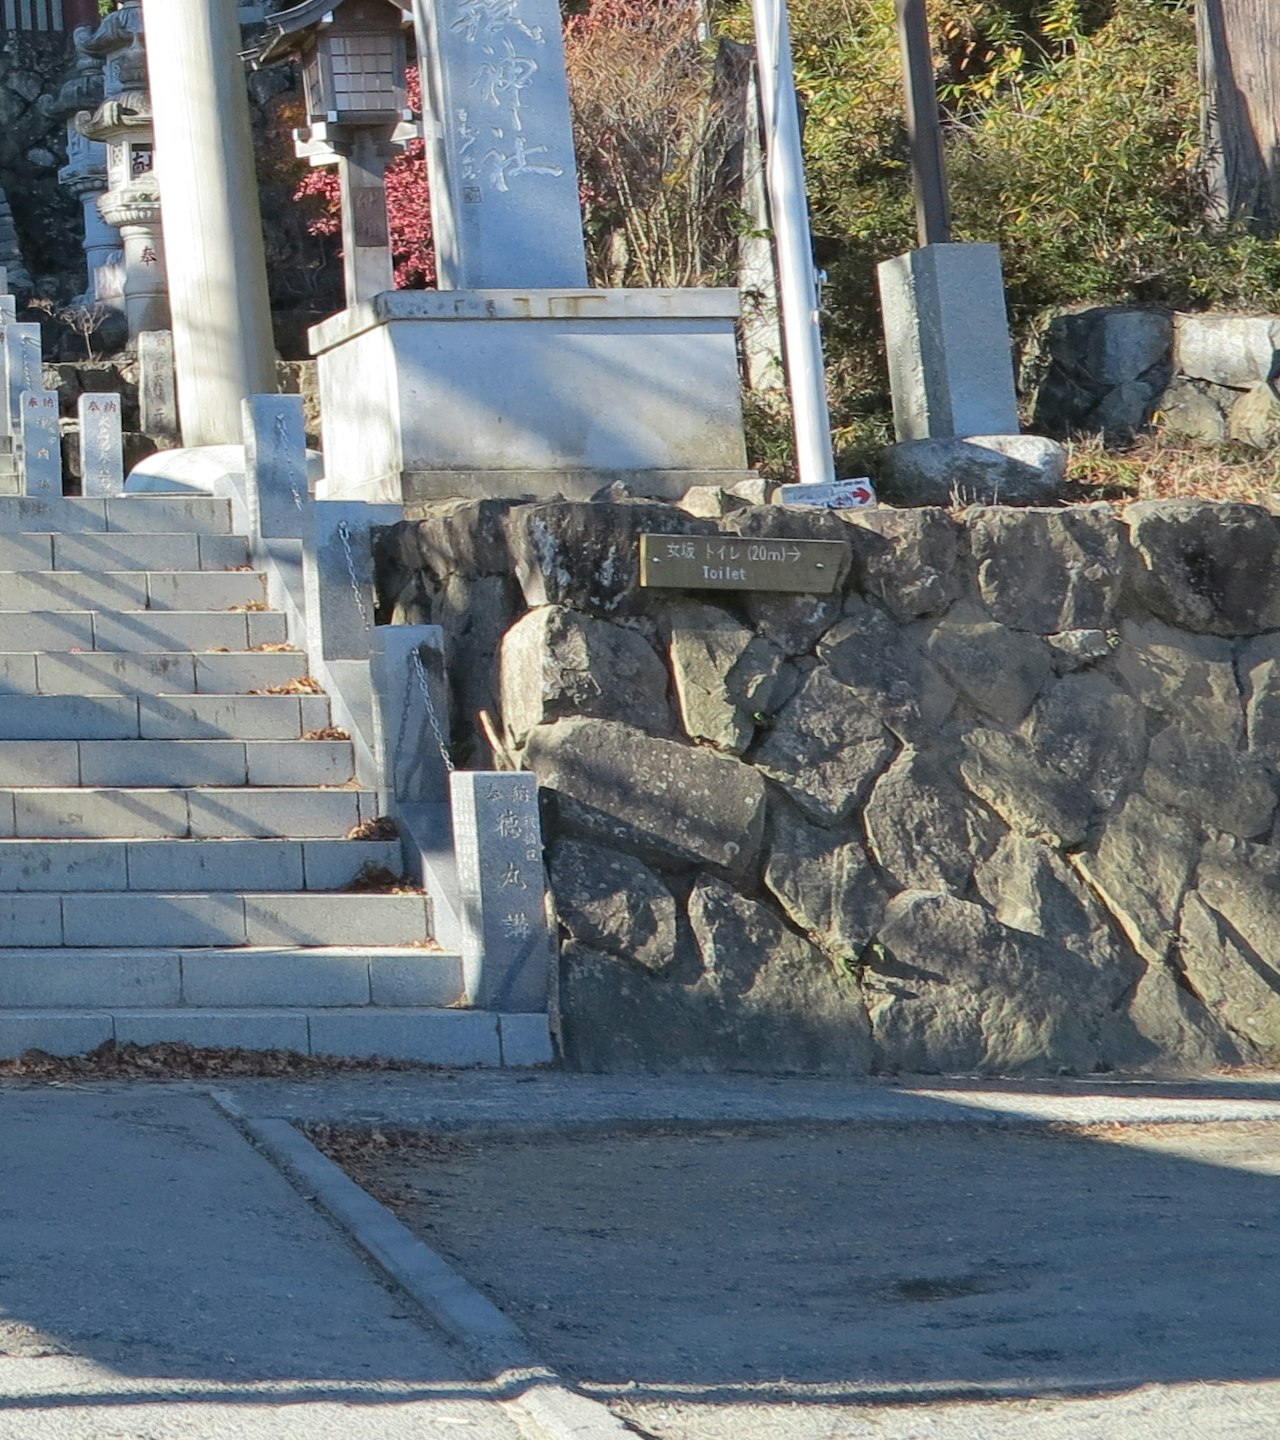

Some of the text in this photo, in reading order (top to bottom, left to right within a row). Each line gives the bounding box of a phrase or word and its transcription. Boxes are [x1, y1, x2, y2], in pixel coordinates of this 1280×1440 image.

[666, 542, 785, 562] 女坂 トイレ (20m)
[702, 565, 747, 580] Toilet
